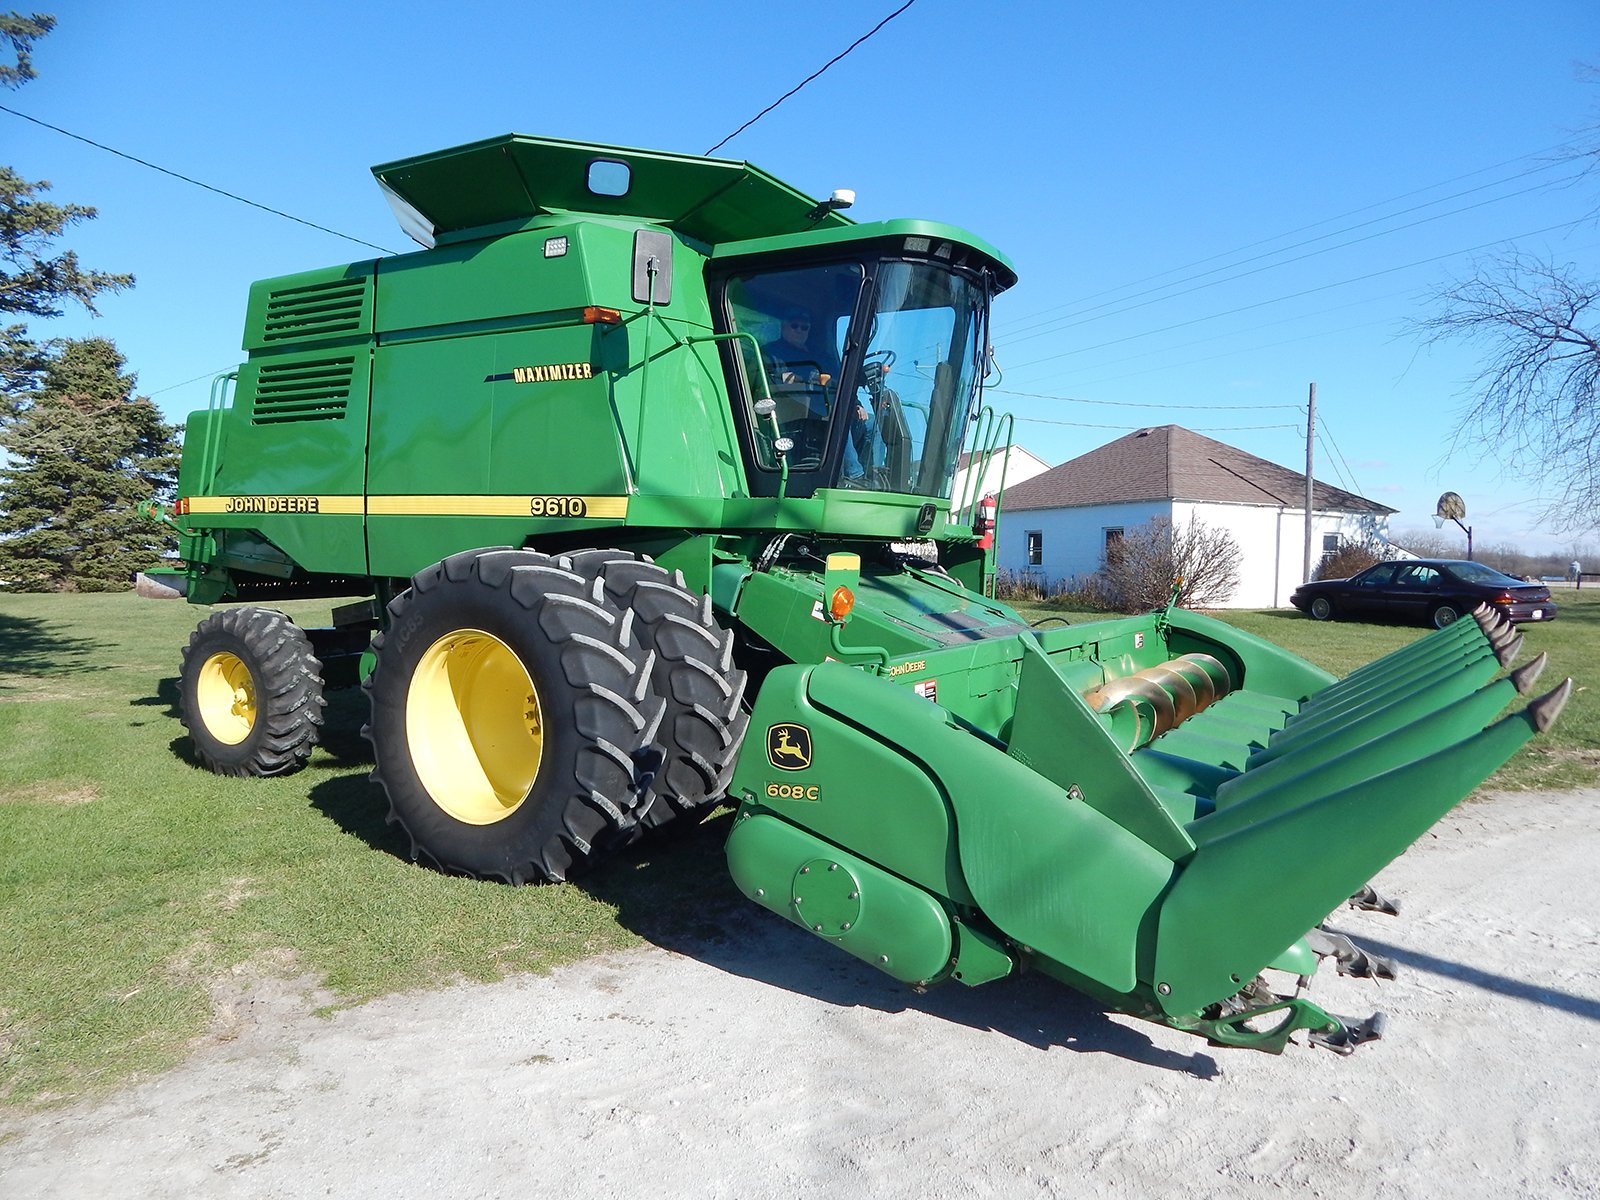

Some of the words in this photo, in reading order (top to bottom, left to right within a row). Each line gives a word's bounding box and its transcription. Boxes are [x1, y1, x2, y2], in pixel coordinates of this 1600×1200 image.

[513, 362, 593, 384] MAXIMIZER
[225, 497, 265, 513] JOHN
[267, 497, 319, 513] DEERE
[531, 497, 587, 517] 9610
[766, 783, 819, 801] 608C
